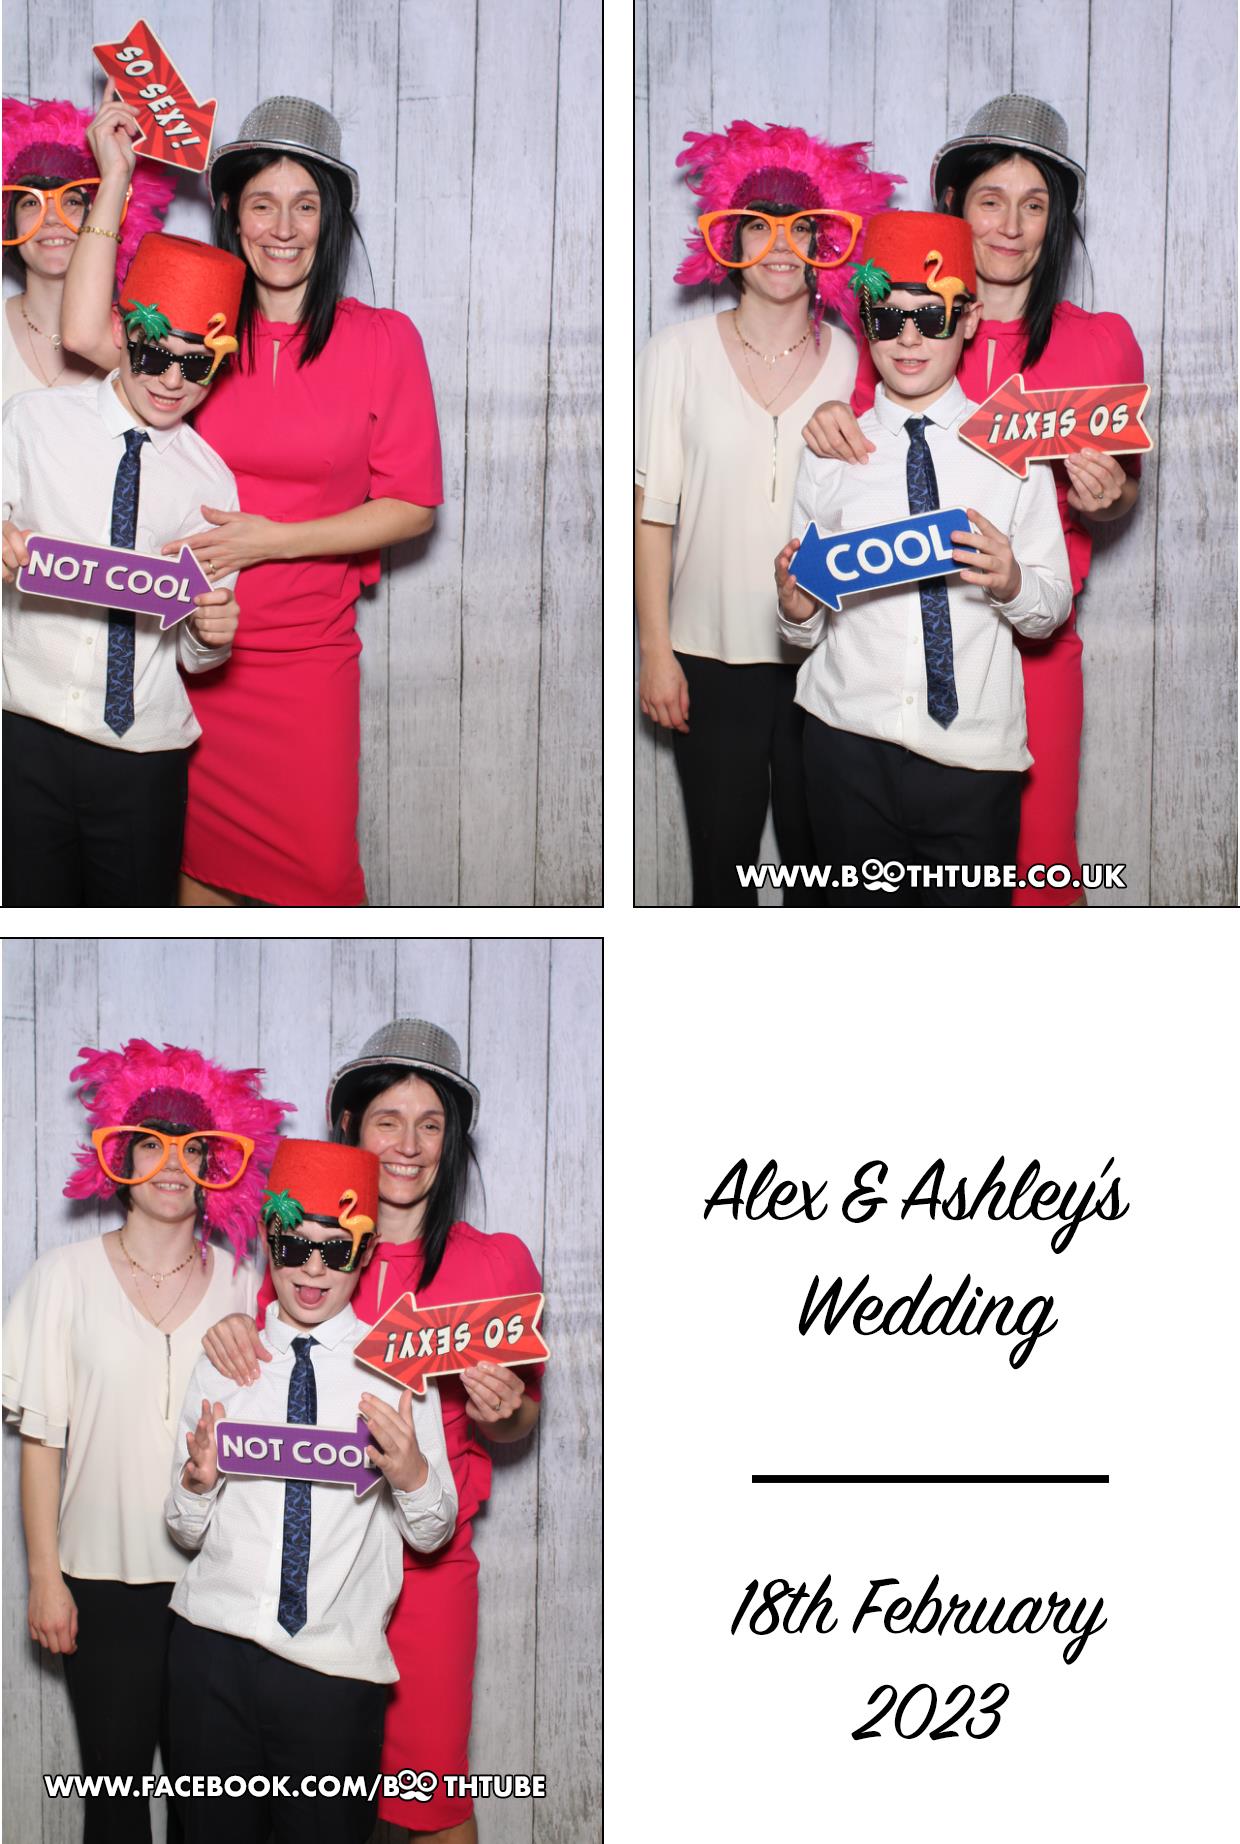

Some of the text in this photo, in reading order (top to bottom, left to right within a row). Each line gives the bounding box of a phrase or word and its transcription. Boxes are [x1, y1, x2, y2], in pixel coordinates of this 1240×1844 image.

[115, 46, 202, 150] SO SEXY!
[988, 402, 1130, 444] SO SEXY!
[27, 550, 192, 603] NOT COOL
[825, 524, 953, 581] COOL
[384, 1314, 524, 1363] SO SEXY!
[222, 1434, 284, 1462] NOT
